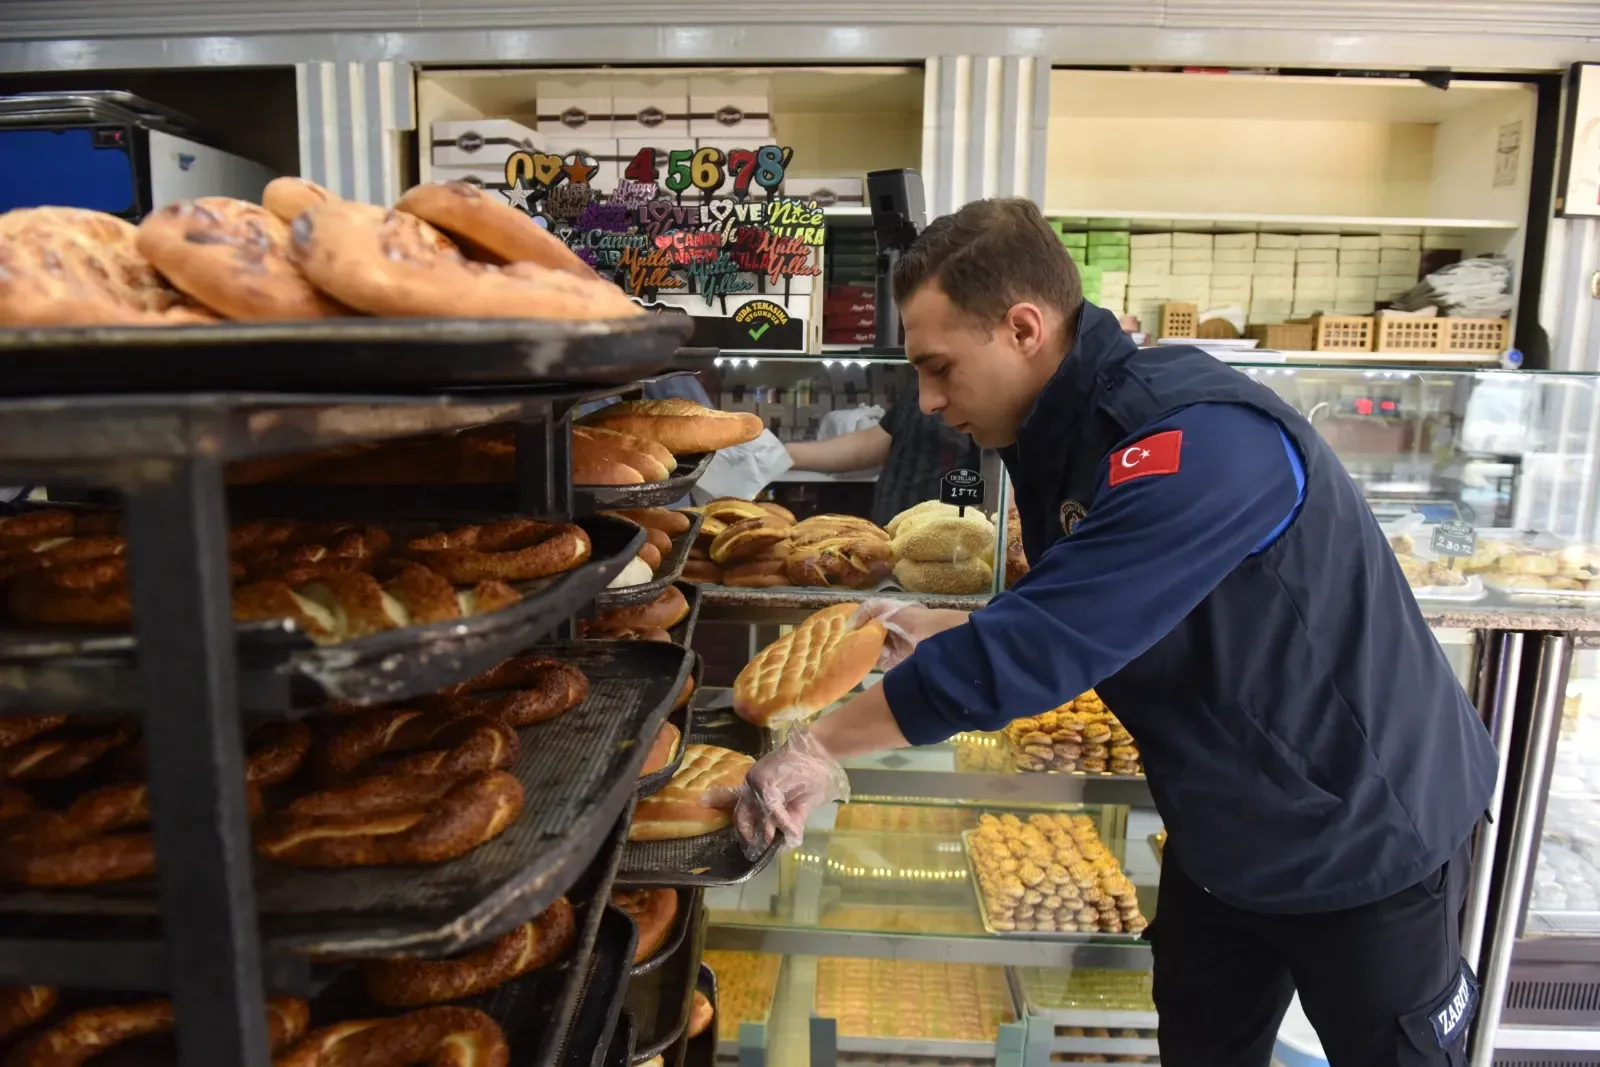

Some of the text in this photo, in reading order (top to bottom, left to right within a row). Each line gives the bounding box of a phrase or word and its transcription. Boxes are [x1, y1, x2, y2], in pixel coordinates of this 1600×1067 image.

[625, 145, 784, 190] 4 5 6 7 8
[768, 200, 823, 225] Nice
[756, 230, 811, 255] Mutlu
[618, 246, 673, 270] Mutlu
[736, 302, 788, 325] GIDA TEMASINA
